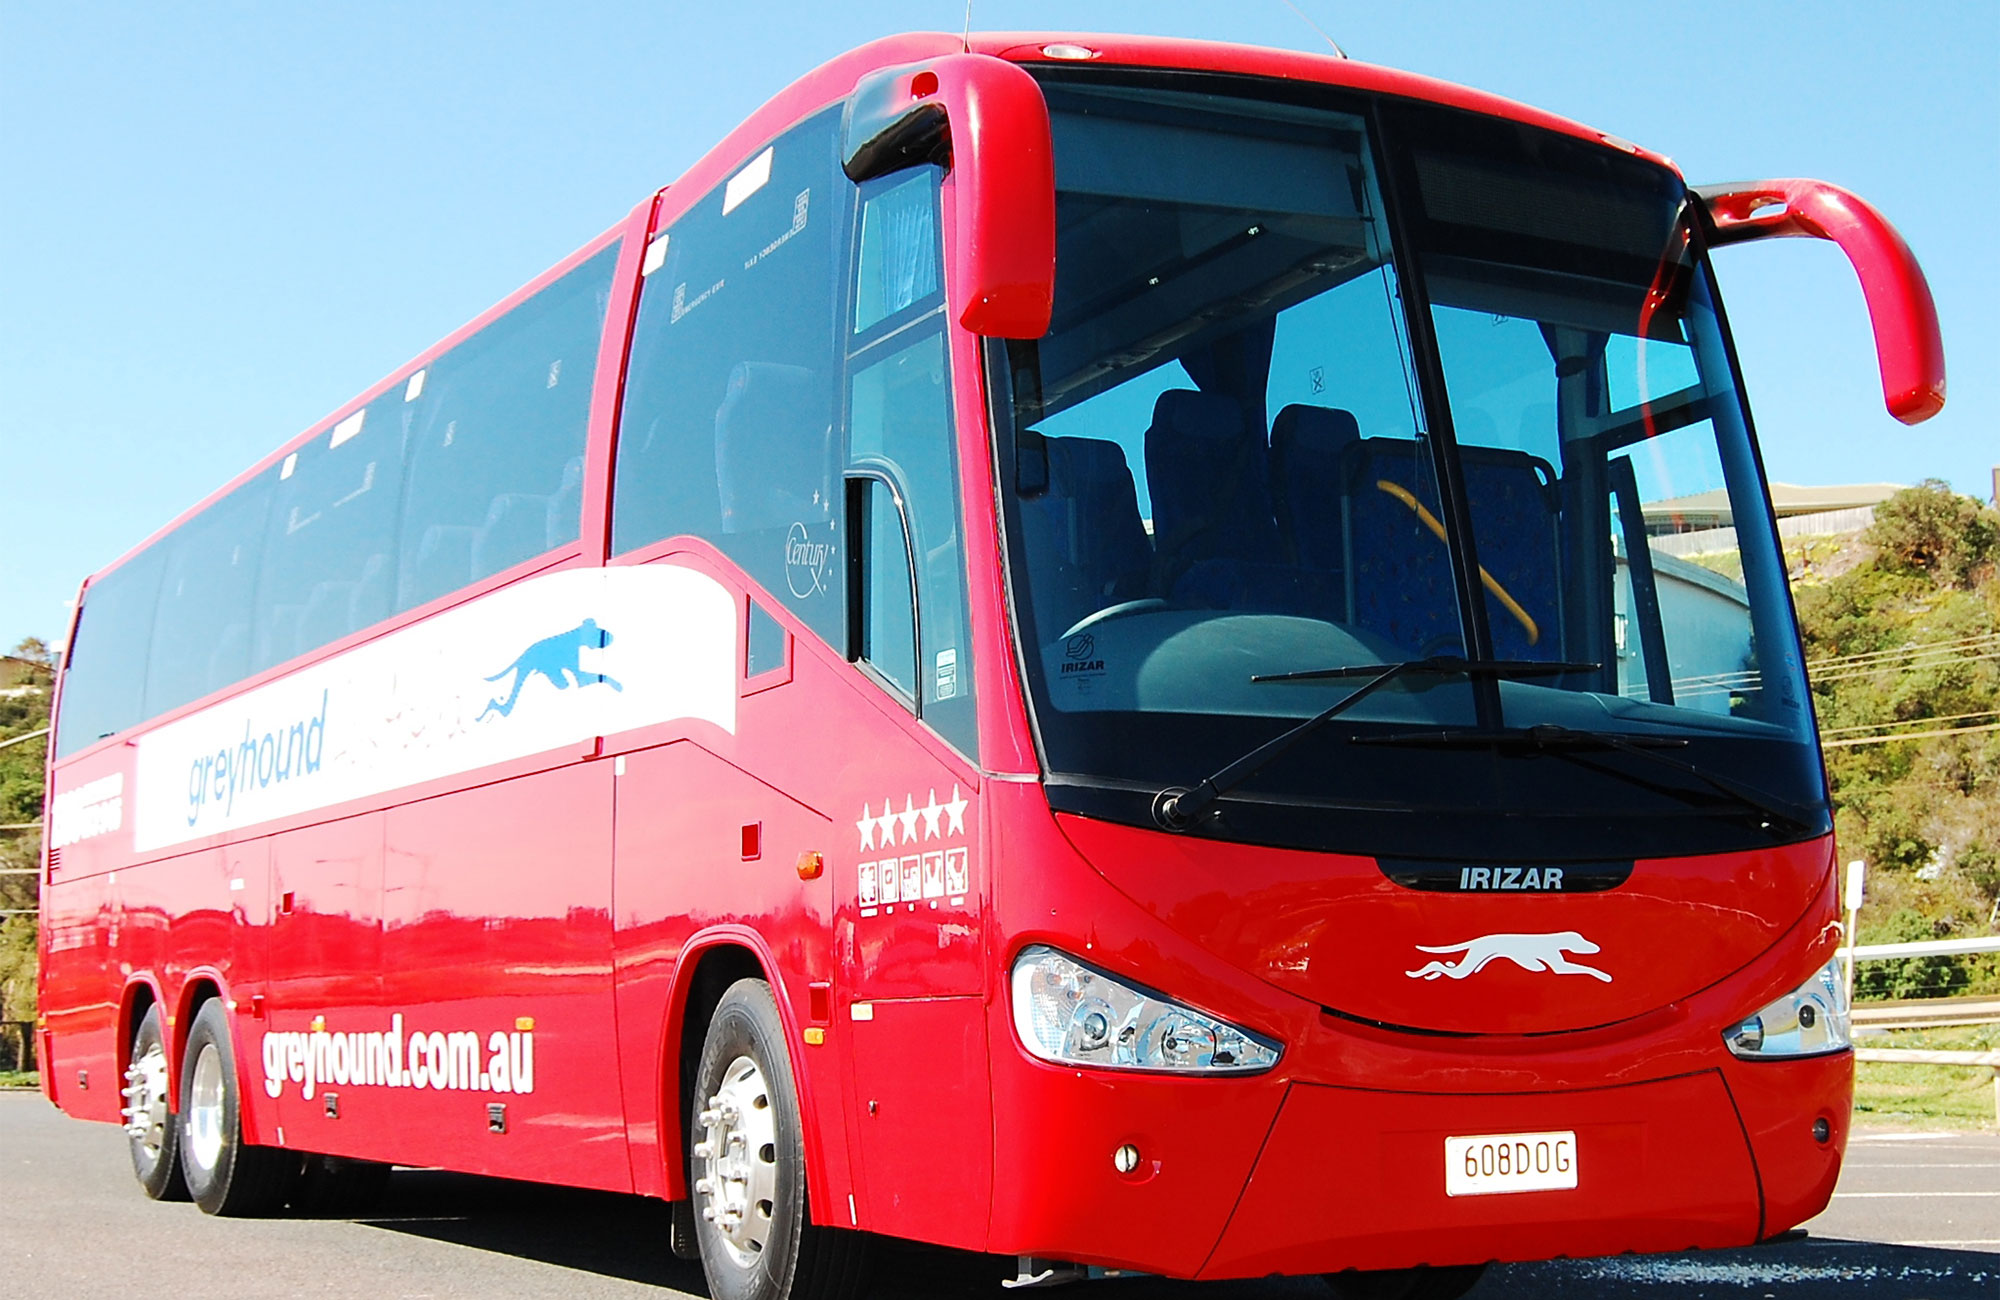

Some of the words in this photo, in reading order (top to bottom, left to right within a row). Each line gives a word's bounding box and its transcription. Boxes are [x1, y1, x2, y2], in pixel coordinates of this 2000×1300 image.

[1061, 660, 1105, 673] IRIZAR
[187, 688, 328, 827] greyhound
[1459, 867, 1564, 889] IRIZAR
[263, 1013, 534, 1100] greyhound.com.au
[1465, 1140, 1570, 1177] 608DOG
